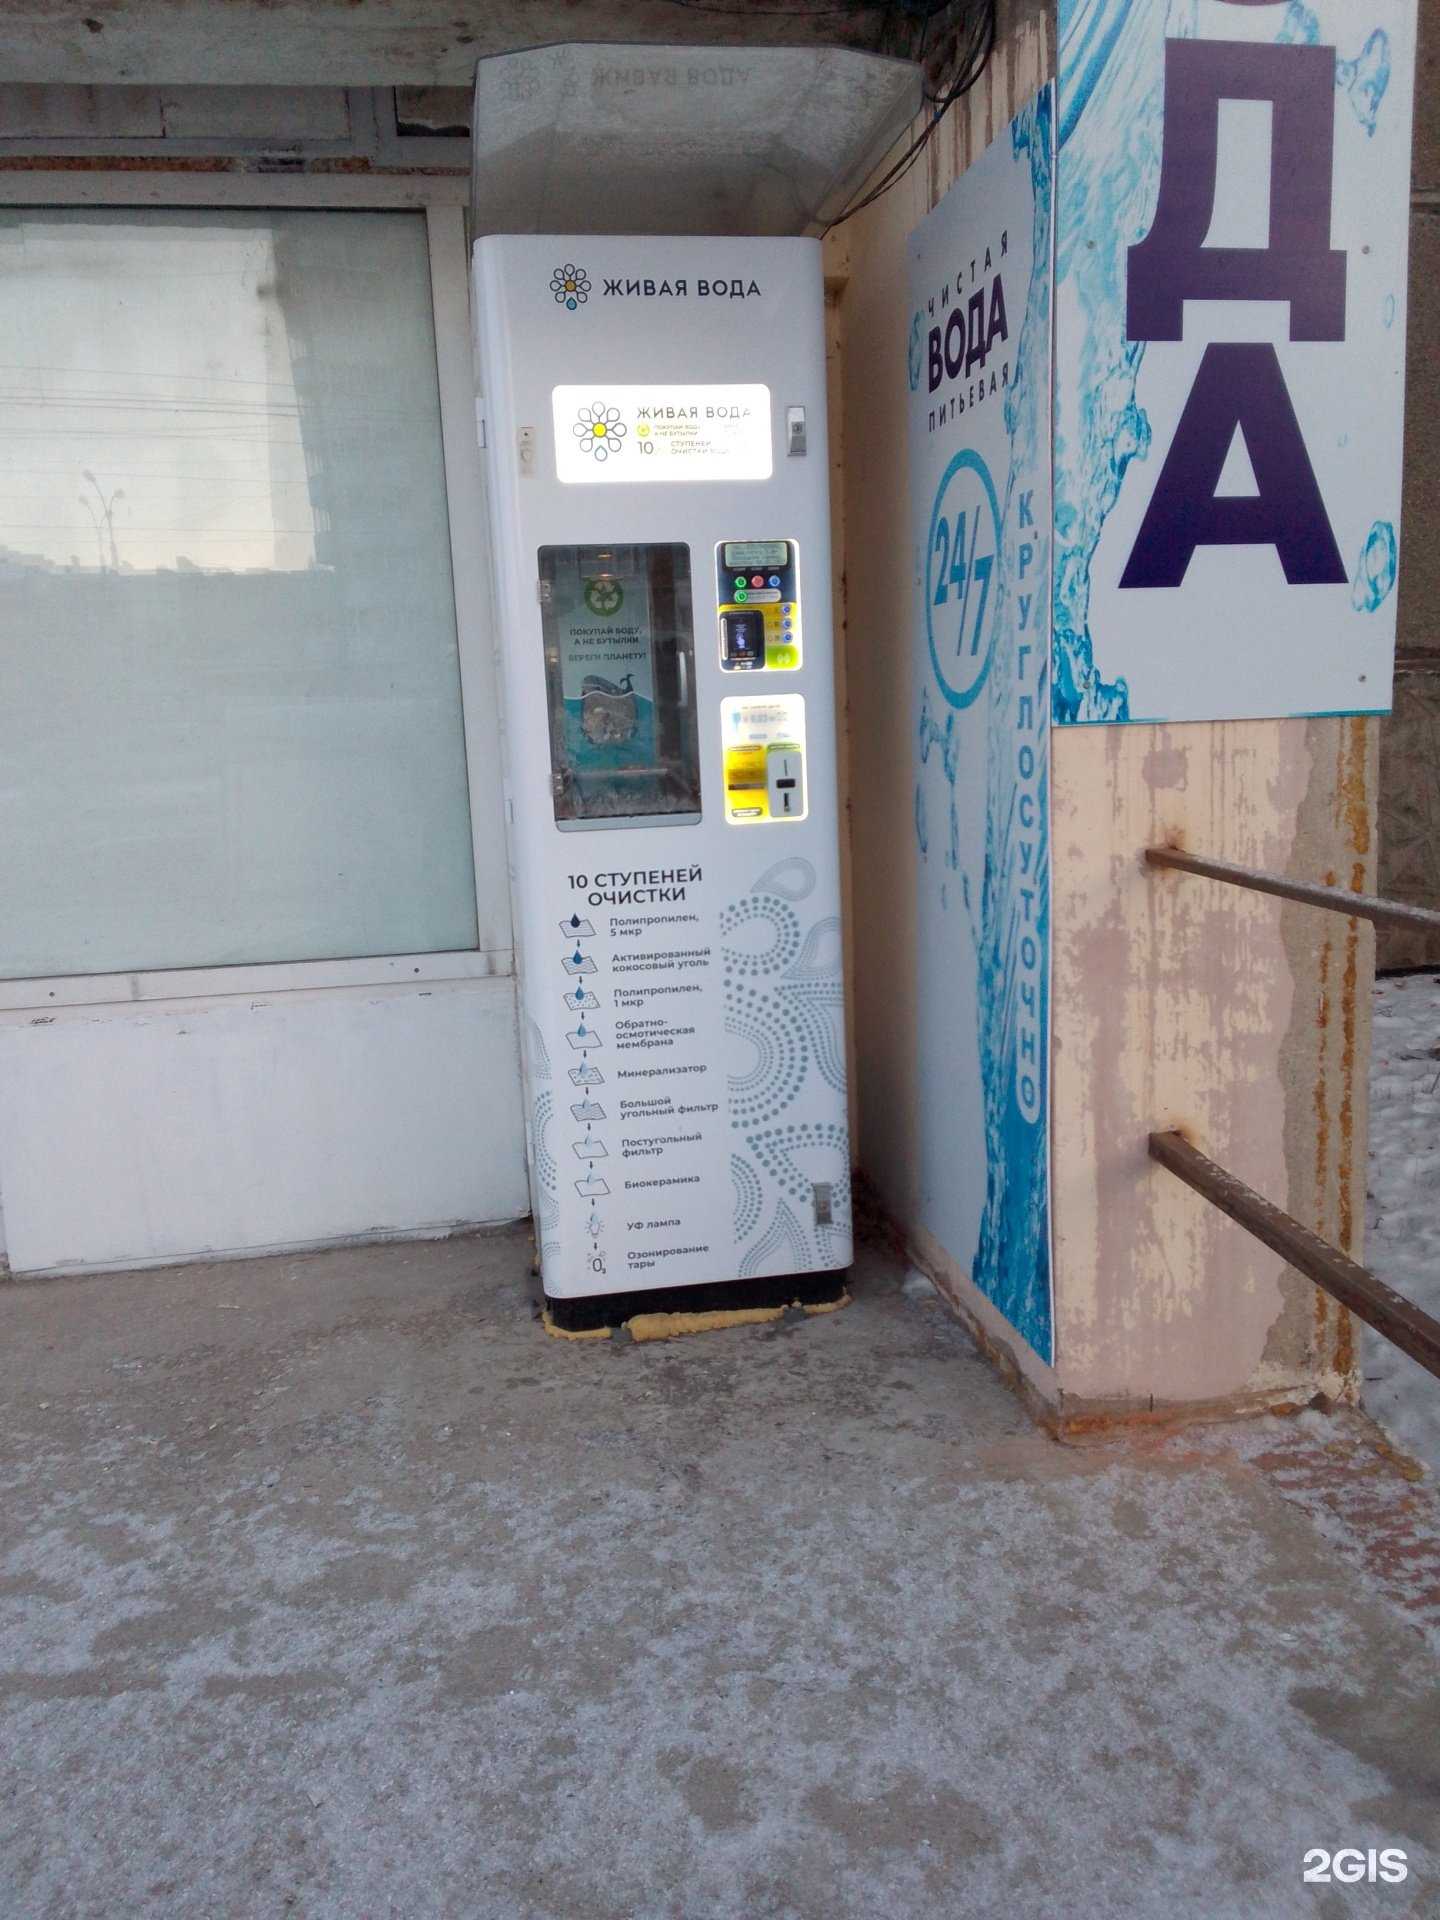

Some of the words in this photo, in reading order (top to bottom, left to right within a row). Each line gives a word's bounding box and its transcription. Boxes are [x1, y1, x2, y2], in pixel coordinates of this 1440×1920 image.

[928, 229, 1008, 318] ЧИСТАЯ
[602, 278, 688, 297] ЖИВАЯ
[697, 278, 762, 299] ВОДА
[1118, 0, 1348, 589] ДА
[928, 273, 1009, 394] ВОДА
[928, 361, 1009, 433] ПИТЬЕВАЯ
[637, 406, 699, 419] ЖИВАЯ
[637, 441, 654, 455] 10
[933, 504, 995, 657] 24/7
[569, 626, 614, 636] ПОКУПАЙ
[574, 637, 582, 646] А
[583, 637, 596, 646] НЕ
[1016, 489, 1036, 1109] КРУГЛОСУТОЧНО
[568, 874, 588, 889] 10
[594, 864, 703, 888] СТУПЕНЕЙ
[588, 887, 686, 907] ОЧИСТКИ
[609, 913, 700, 928] Полипропилен,
[610, 928, 617, 937] 5
[620, 927, 643, 938] мкр
[611, 947, 711, 963] Активированный
[612, 962, 675, 973] кокосовый
[677, 960, 710, 973] уголь
[613, 985, 703, 998] Полипропилен,
[613, 999, 619, 1007] 1
[621, 999, 644, 1009] мкр
[615, 1019, 668, 1030] Обратно-
[615, 1026, 696, 1040] осмотическая
[616, 1038, 674, 1050] мембрана
[617, 1064, 708, 1079] Минерализатор
[620, 1095, 672, 1109] Большой
[620, 1107, 675, 1121] угольный
[677, 1102, 719, 1115] фильтр
[621, 1131, 703, 1148] Постугольный
[621, 1145, 664, 1158] фильтр
[624, 1175, 701, 1189] Биокерамика
[626, 1221, 644, 1231] УФ
[646, 1217, 681, 1229] лампа
[627, 1245, 710, 1261] Озонирование
[628, 1260, 656, 1270] тары
